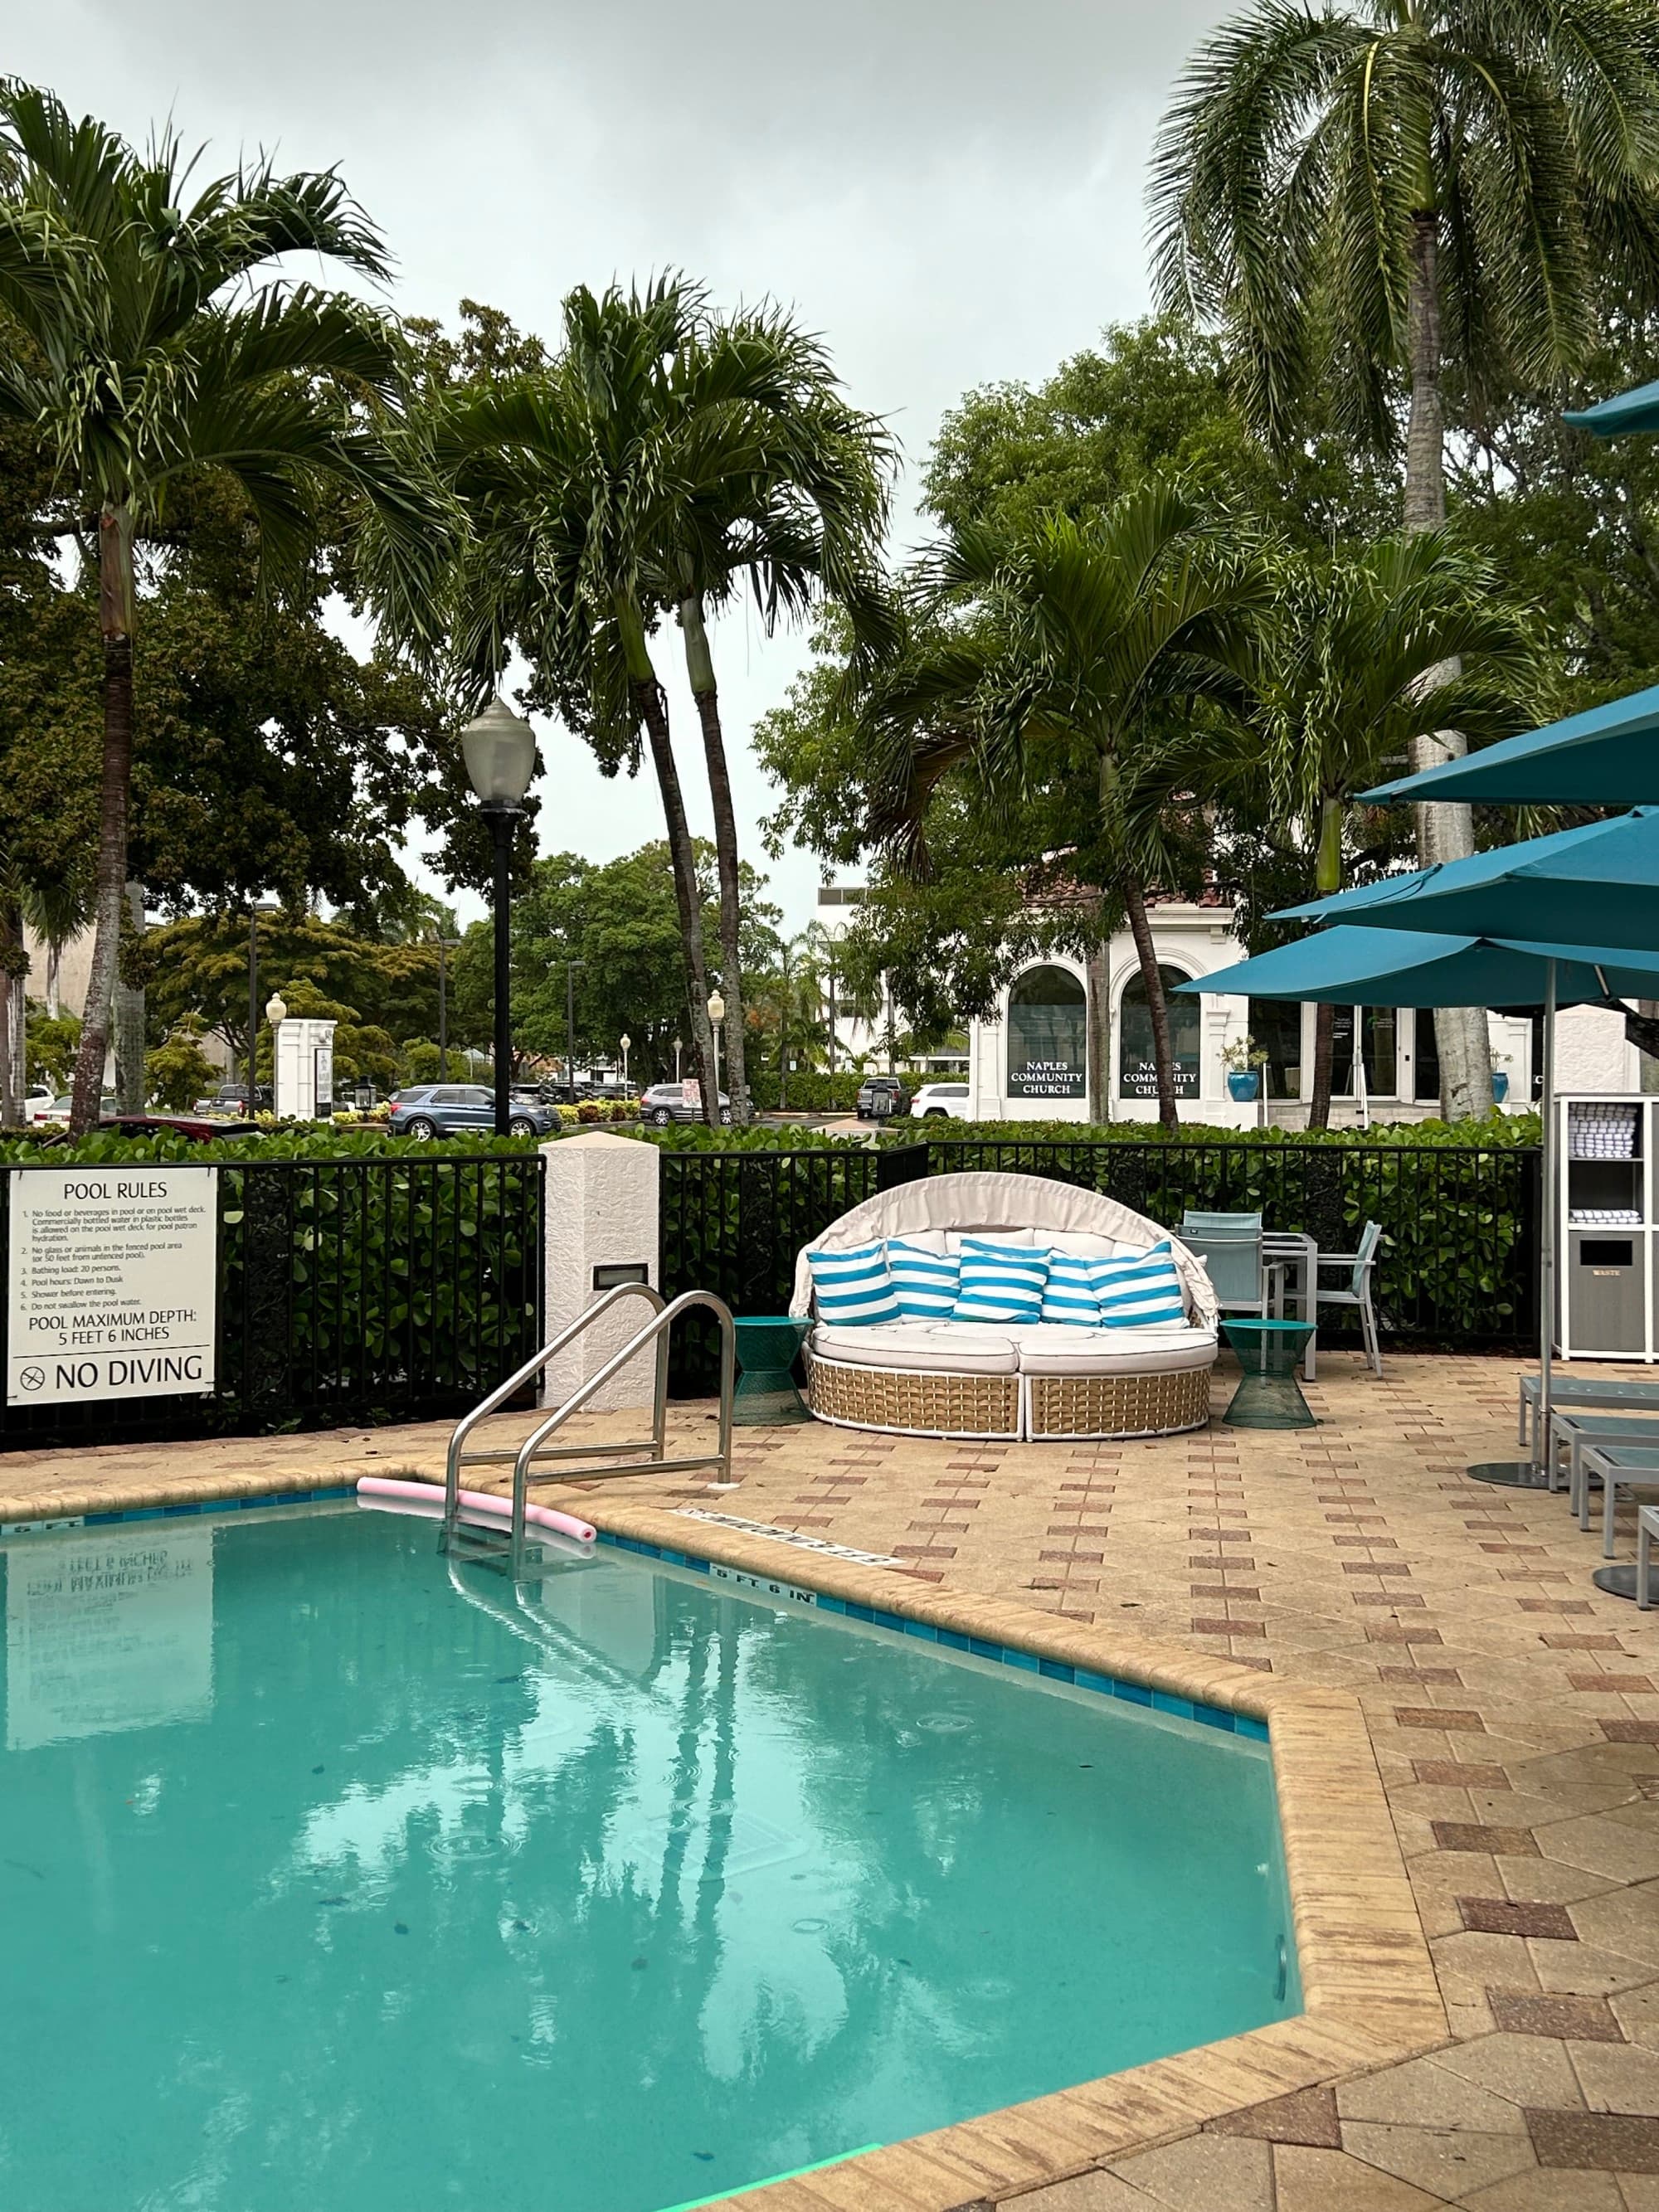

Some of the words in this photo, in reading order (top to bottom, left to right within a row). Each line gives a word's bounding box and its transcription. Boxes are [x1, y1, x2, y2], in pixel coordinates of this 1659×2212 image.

[1026, 1062, 1068, 1071] NAPLES
[1139, 1062, 1181, 1071] NAS
[1011, 1073, 1082, 1082] COMMUNITY
[1123, 1073, 1196, 1082] COMMITY
[1023, 1085, 1070, 1094] CHURCH
[1136, 1085, 1184, 1094] CHUH
[64, 1183, 112, 1199] POOL
[117, 1181, 168, 1198] RULES
[74, 1209, 109, 1218] beverages
[119, 1208, 135, 1216] pool
[158, 1207, 173, 1215] pool
[32, 1217, 81, 1226] Commercially
[83, 1216, 109, 1224] bottled
[141, 1214, 163, 1223] plastic
[164, 1213, 188, 1222] bottles
[95, 1224, 110, 1232] pool
[158, 1223, 173, 1231] pool
[174, 1222, 197, 1230] patron
[44, 1246, 62, 1254] glass
[74, 1244, 101, 1252] animals
[126, 1242, 148, 1251] fenced
[150, 1242, 165, 1251] pool
[45, 1253, 55, 1262] 50
[72, 1252, 90, 1261] from
[92, 1251, 124, 1260] unfenced
[32, 1266, 60, 1275] Bathing
[80, 1265, 90, 1273] 20
[32, 1278, 48, 1286] Pool
[50, 1277, 71, 1286] hours:
[74, 1276, 95, 1285] Dawn
[105, 1275, 124, 1283] Dusk
[32, 1290, 59, 1298] Shower
[102, 1299, 119, 1308] pool
[29, 1316, 68, 1330] POOL
[72, 1312, 144, 1328] MAXIMUM
[149, 1309, 197, 1325] DEPTH:
[59, 1332, 67, 1345] 5
[72, 1330, 103, 1344] FEET
[108, 1330, 116, 1342] 6
[121, 1327, 169, 1342] INCHES
[56, 1362, 99, 1389] NO
[109, 1355, 202, 1386] DIVING
[769, 1584, 781, 1593] 6
